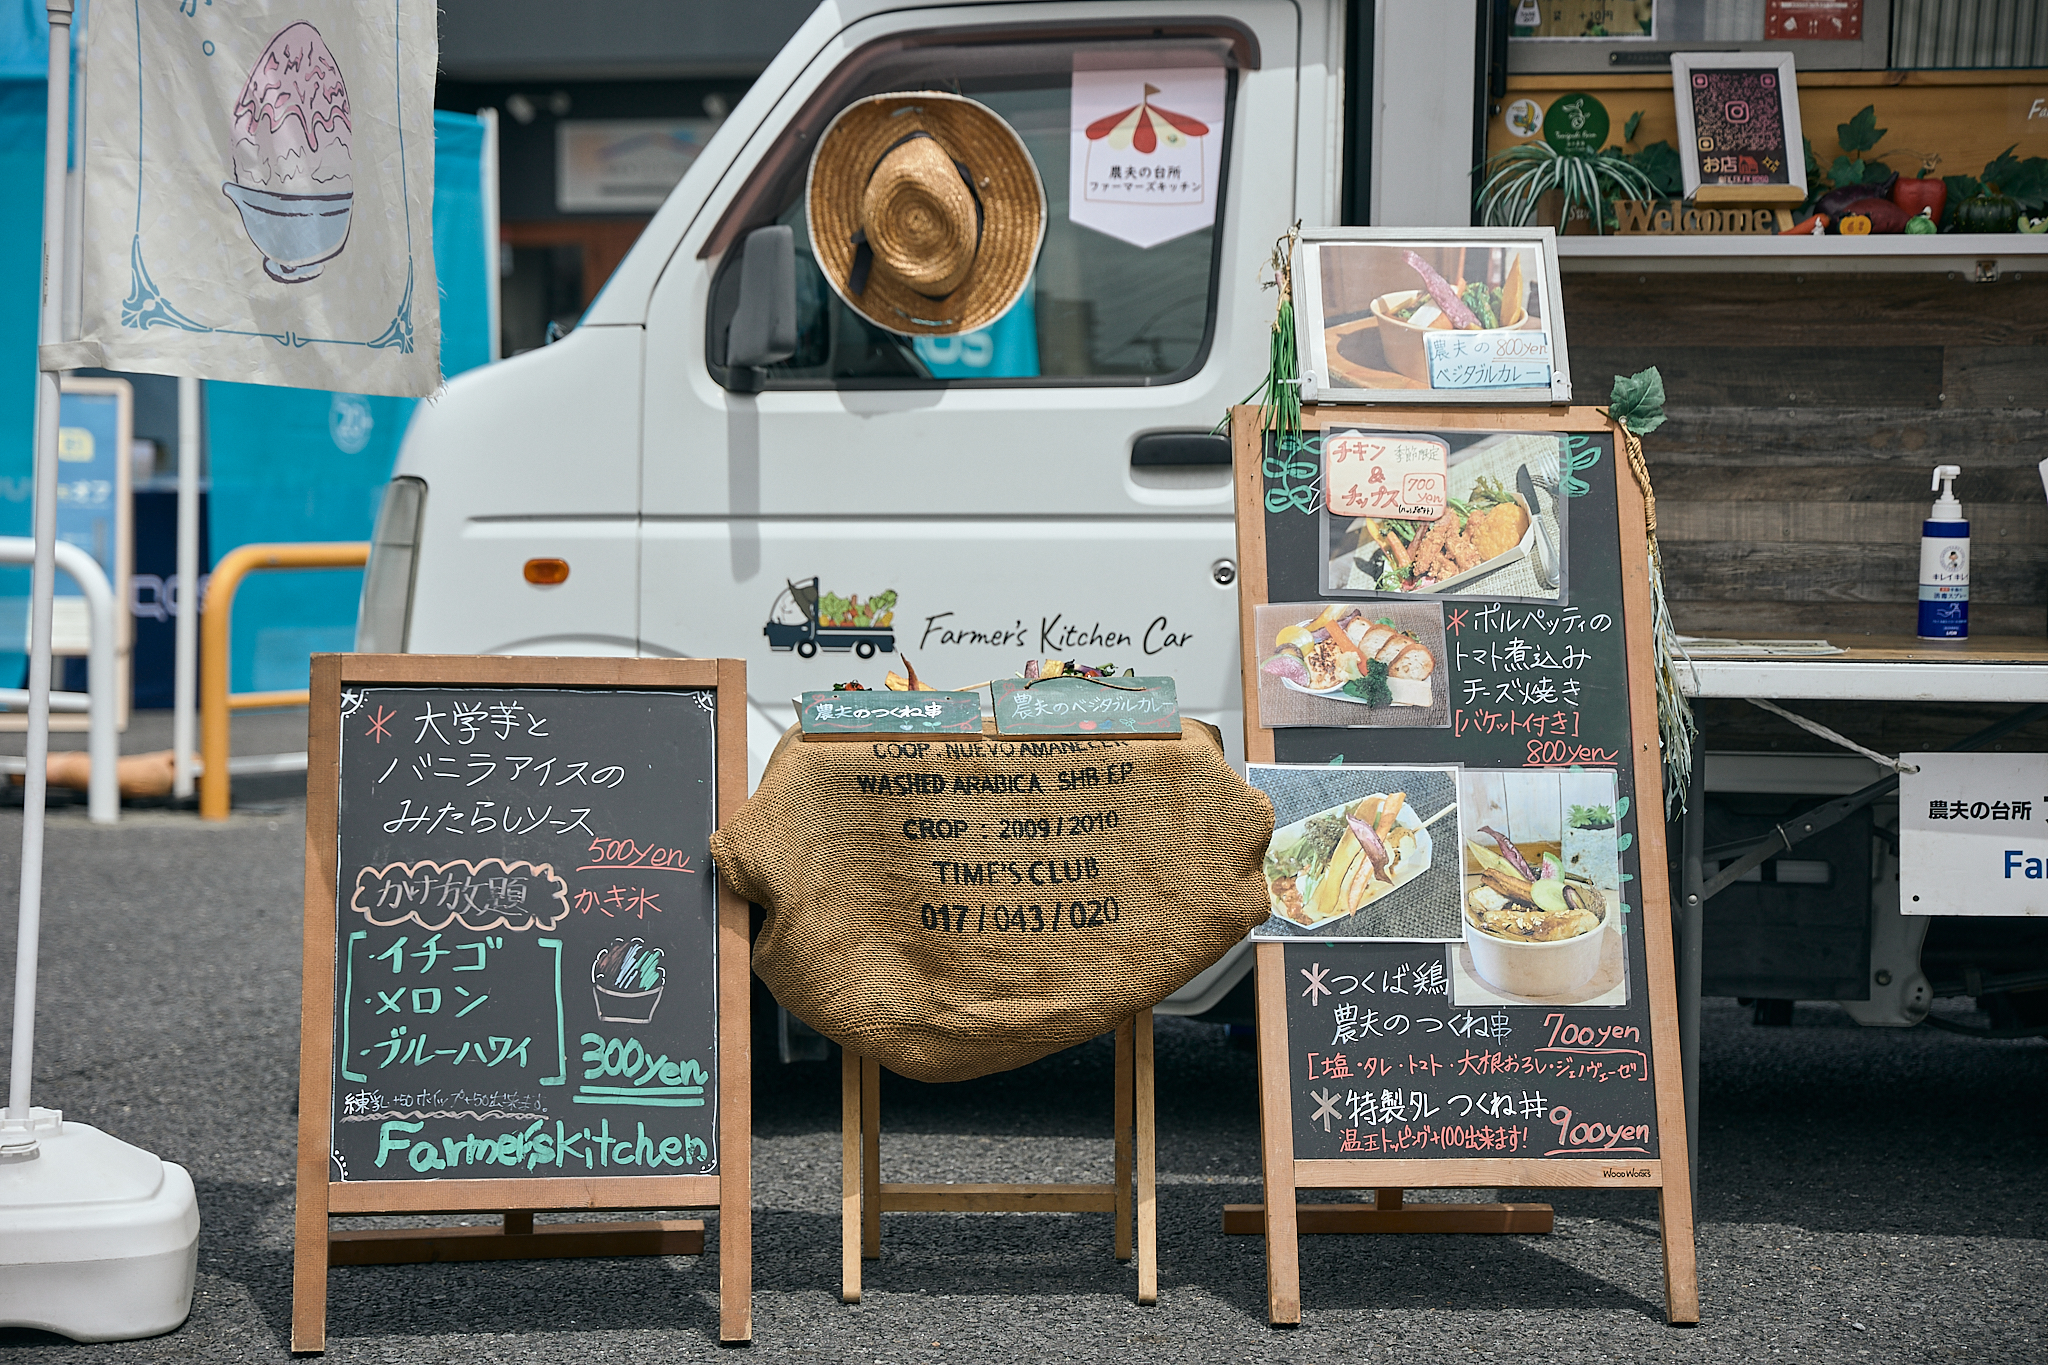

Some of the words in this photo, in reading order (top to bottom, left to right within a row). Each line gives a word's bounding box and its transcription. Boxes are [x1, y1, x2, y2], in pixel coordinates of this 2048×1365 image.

[1109, 164, 1182, 180] 農夫の台所
[1703, 155, 1738, 173] お店
[1089, 181, 1202, 193] ファーマーズキッチン
[1614, 200, 1773, 235] Welcome
[1433, 339, 1490, 361] 農夫の
[1496, 338, 1548, 357] 800yen
[1436, 363, 1541, 384] ベジタブルカレー
[1332, 440, 1386, 463] チキン
[1368, 466, 1386, 484] &
[1408, 478, 1436, 491] 700
[1341, 484, 1401, 509] チップス
[1417, 492, 1444, 504] yen
[1474, 602, 1612, 635] ポルペッティの
[919, 611, 1028, 650] Farmer's
[1040, 613, 1131, 654] Kitchen
[1142, 616, 1193, 655] Car
[1456, 637, 1592, 672] トマト煮込み
[1463, 676, 1581, 706] チーズ焼き
[815, 701, 943, 721] 農夫のつくね串
[1012, 693, 1174, 720] 農夫のベジタブルカレー
[414, 700, 550, 746] 大学芋と
[946, 742, 1015, 759] NUEVO
[1526, 739, 1619, 764] 800yen
[377, 752, 626, 789] バニラアイスの
[856, 773, 946, 797] WASHED
[953, 772, 1045, 796] ARABICA
[1058, 766, 1100, 791] SHB
[383, 799, 595, 837] みたらしソース
[1929, 800, 2032, 821] 農夫の台所
[903, 817, 968, 840] CROP
[587, 836, 692, 869] 500yen
[1028, 856, 1100, 886] CLUB
[574, 884, 663, 920] かき氷
[1331, 960, 1449, 996] つくば鶏
[1543, 1013, 1640, 1048] 700yen
[579, 1033, 709, 1086] 300yen
[1549, 1106, 1650, 1149] 900yen
